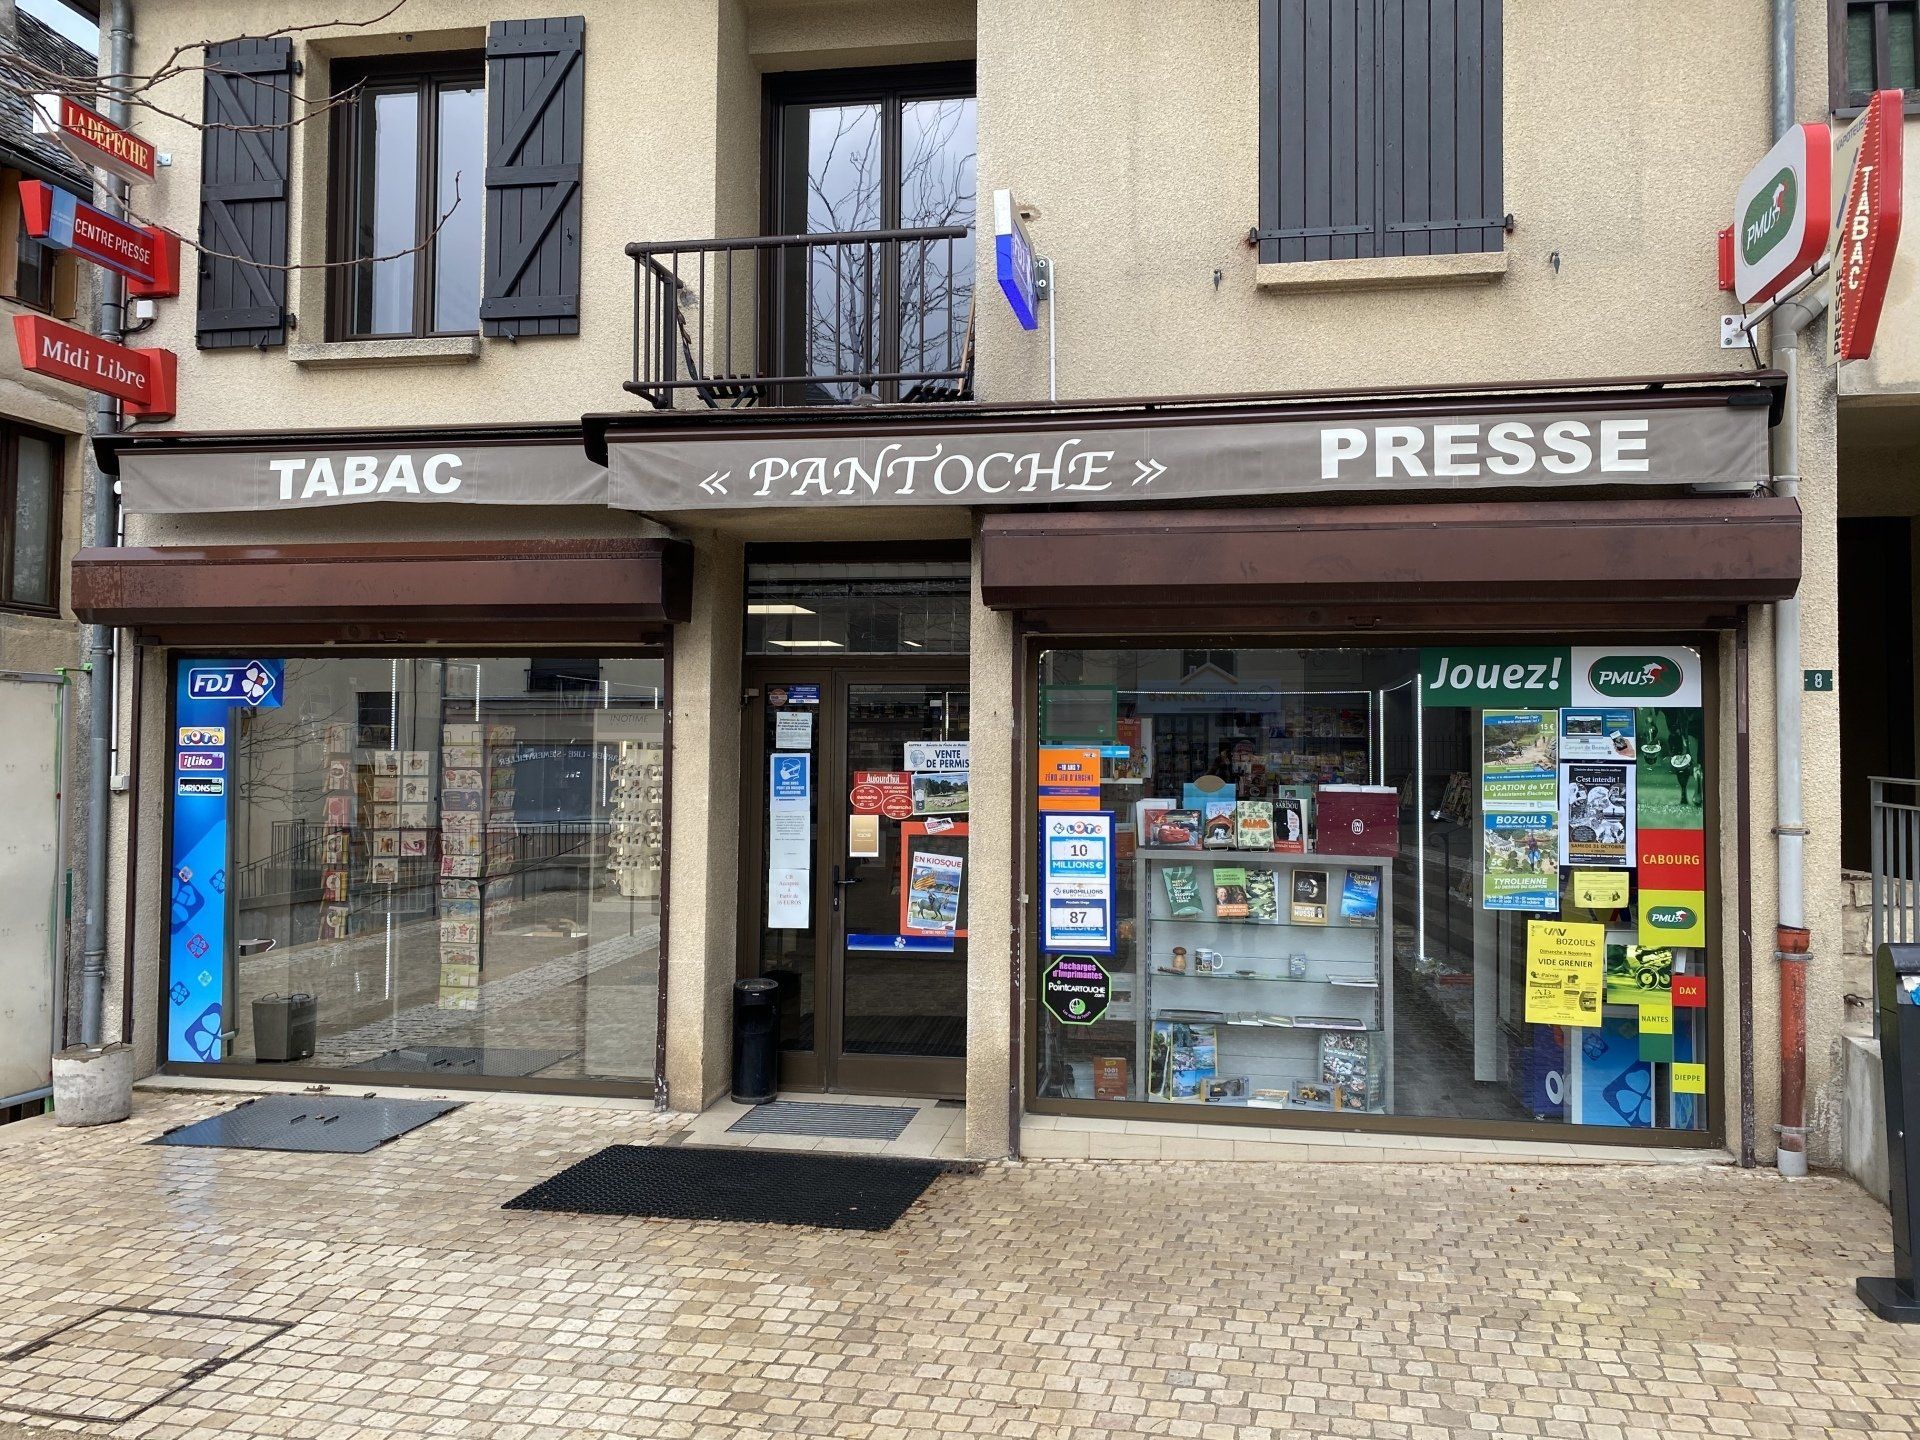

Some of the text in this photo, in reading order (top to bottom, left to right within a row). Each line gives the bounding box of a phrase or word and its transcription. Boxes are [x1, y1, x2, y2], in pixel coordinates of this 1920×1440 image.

[1747, 207, 1773, 251] PMU
[1849, 165, 1874, 290] TABAC
[75, 218, 151, 265] CENTRE PRESSE
[1833, 269, 1843, 356] PRESSE
[42, 335, 146, 389] Midi Libre
[1320, 419, 1650, 479] PRESSE
[748, 438, 1115, 496] PANTOCHE
[269, 453, 463, 500] TABAC
[1429, 657, 1562, 690] Jouez!
[1598, 670, 1640, 685] PMU
[193, 673, 234, 693] FDJ
[1814, 672, 1823, 689] 8
[934, 750, 961, 759] VENTE
[926, 760, 970, 768] DE PERMIS
[866, 773, 900, 784] Aujourd'hui
[1575, 775, 1591, 783] C'est
[180, 784, 211, 792] PARIONS
[1484, 783, 1526, 792] LOCATION
[1496, 815, 1547, 824] BOZOULS
[1066, 821, 1102, 834] LOTO
[1070, 844, 1088, 857] 10
[926, 858, 962, 868] KIOSQUE
[1052, 861, 1104, 869] MILLIONS €
[1642, 854, 1700, 865] CABOURG
[1493, 877, 1549, 885] TYROLIENNE
[1069, 911, 1087, 924] 87
[1294, 909, 1315, 917] MUSSO
[1651, 913, 1675, 922] PMU
[1556, 938, 1596, 947] BOZOULS
[1059, 961, 1097, 971] Recharges
[1538, 958, 1593, 968] VIDE GRENIER
[1052, 969, 1103, 980] d'Imprimantes
[1679, 986, 1697, 995] DAX
[1641, 1015, 1669, 1023] NANTES
[1674, 1073, 1701, 1082] DIEPPE
